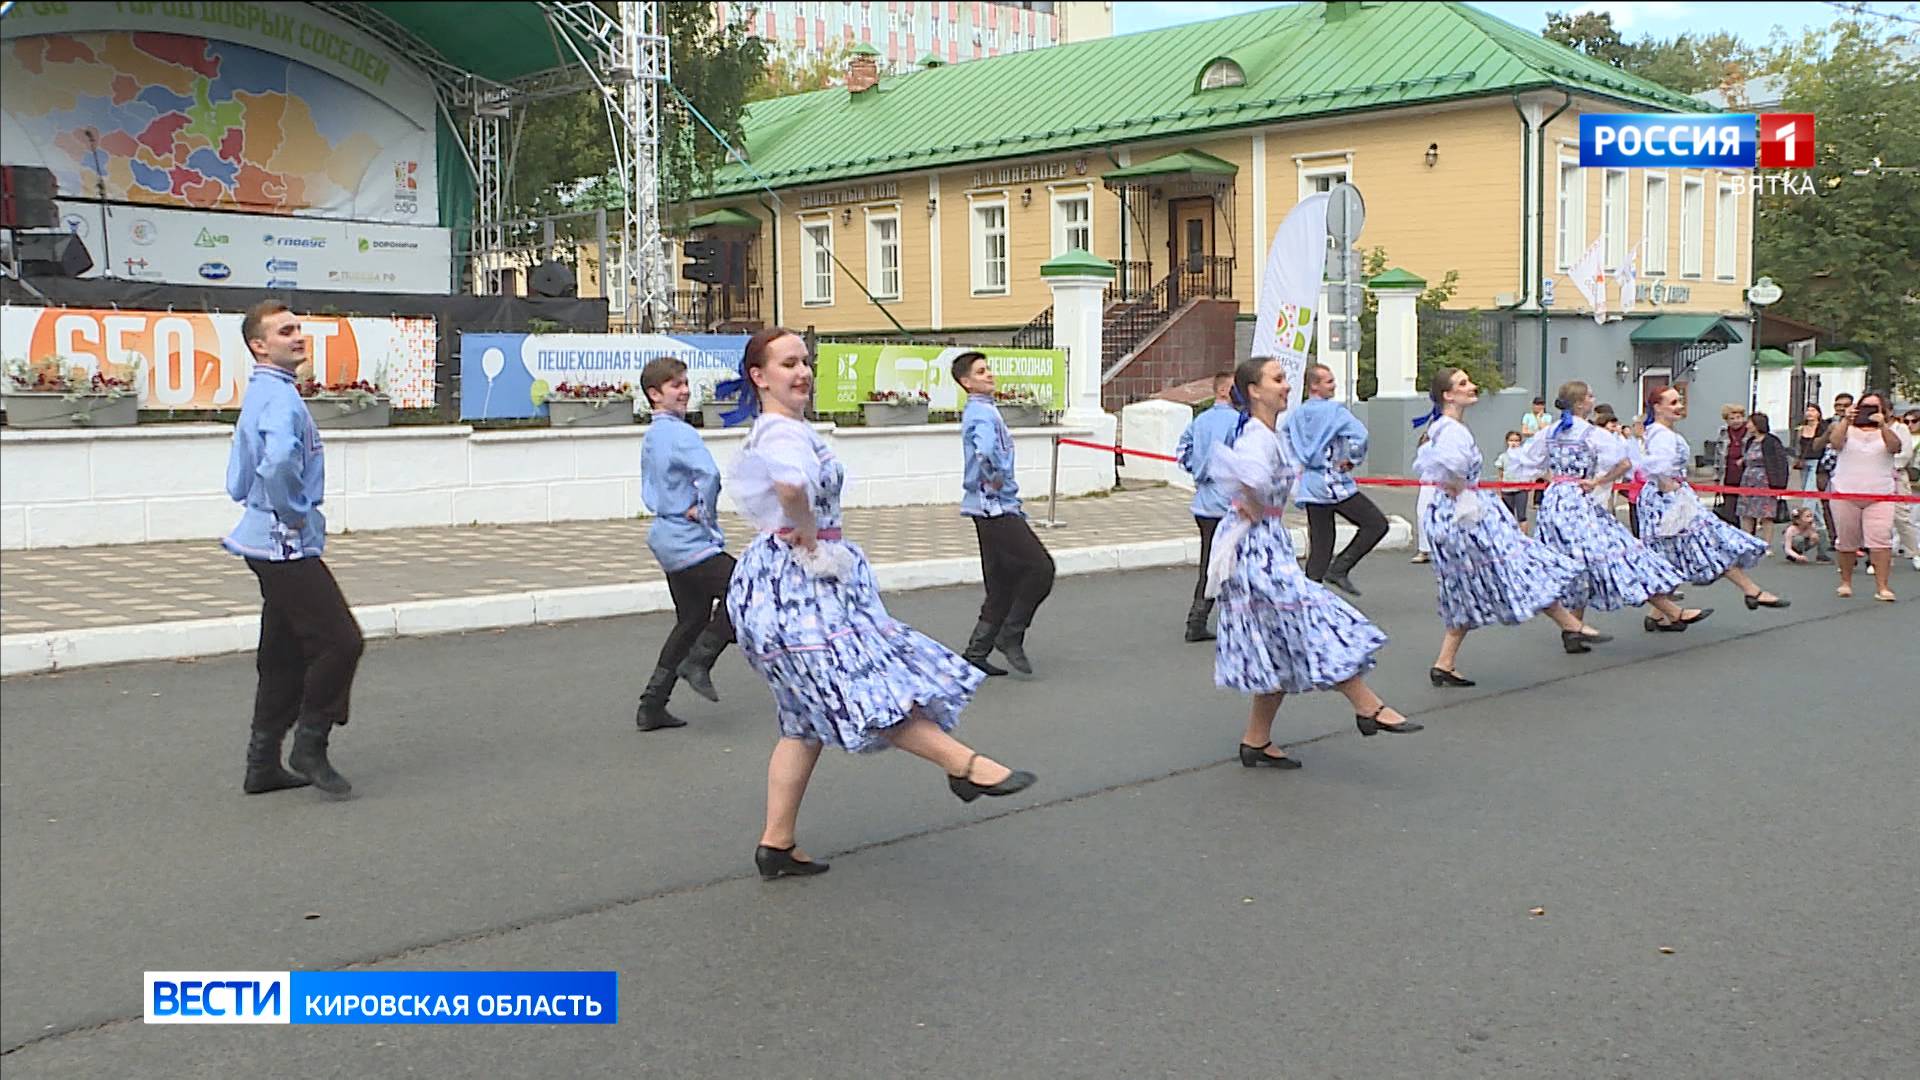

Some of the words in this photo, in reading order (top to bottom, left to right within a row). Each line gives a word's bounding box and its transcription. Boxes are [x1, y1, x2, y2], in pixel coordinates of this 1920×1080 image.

[202, 2, 294, 44] ДОБРЫХ
[55, 315, 195, 405] 650
[537, 350, 631, 370] ПЕШЕХОДНАЯ
